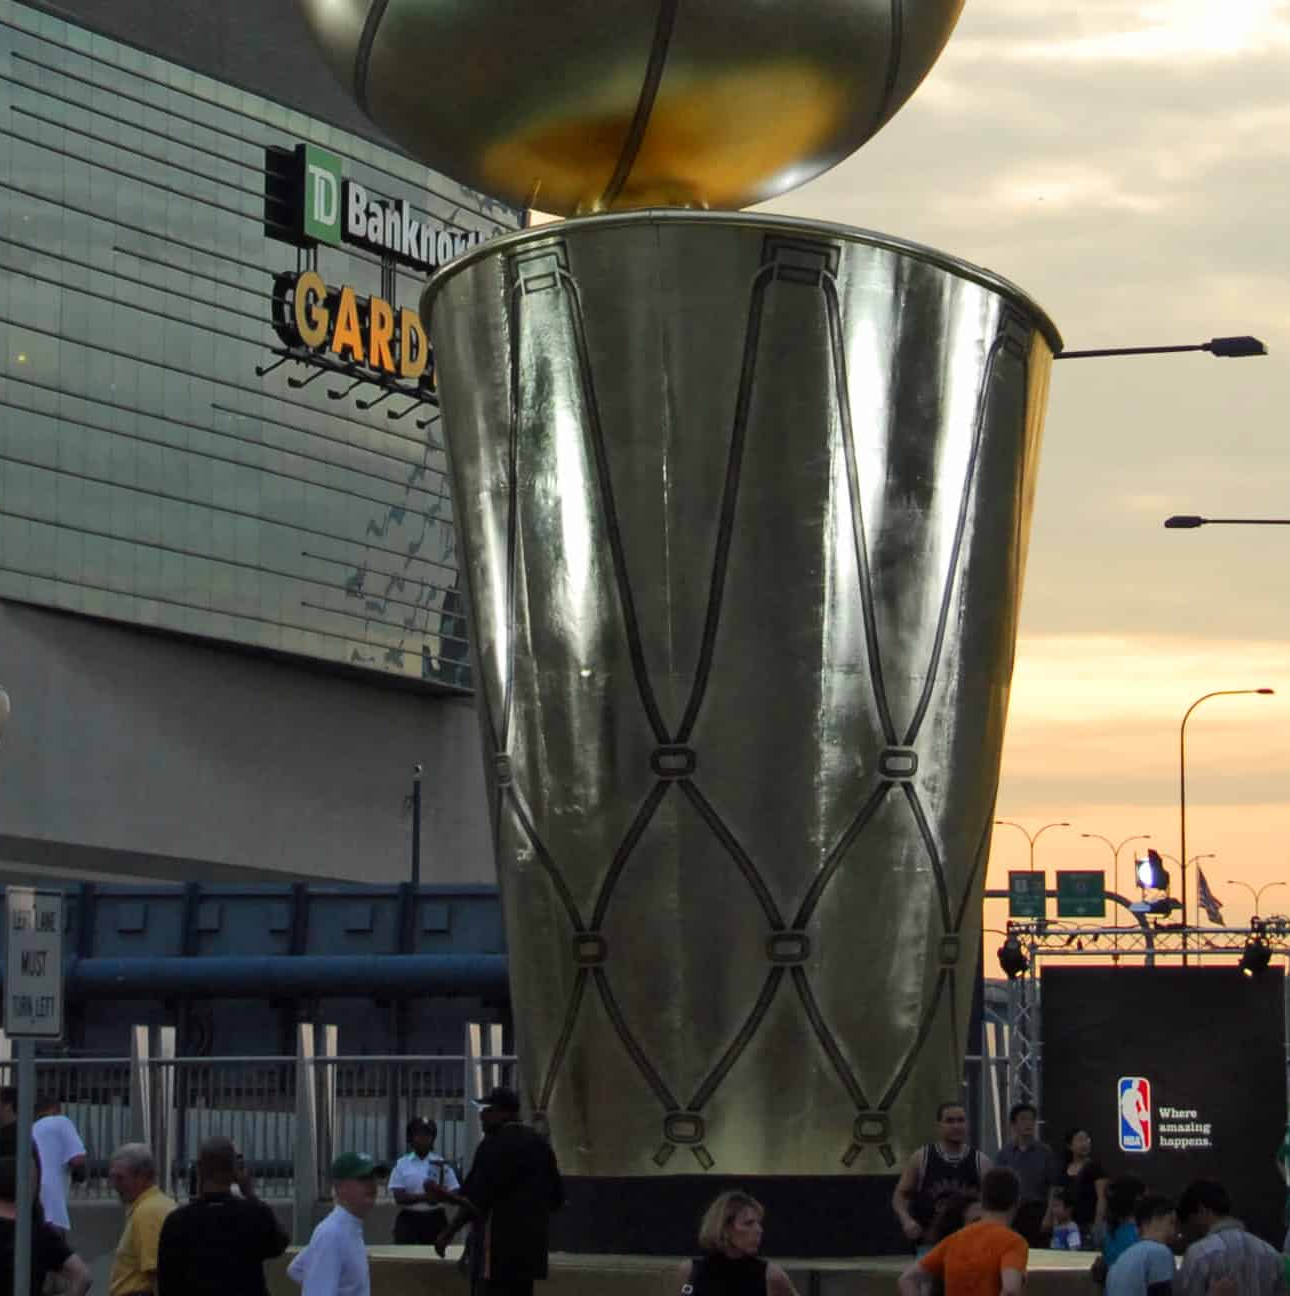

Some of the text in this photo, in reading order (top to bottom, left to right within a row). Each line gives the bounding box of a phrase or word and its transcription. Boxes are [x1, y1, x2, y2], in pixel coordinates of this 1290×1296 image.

[308, 164, 338, 226] TD
[294, 271, 438, 387] GARD
[36, 911, 56, 932] LANE
[20, 951, 47, 977] MUST
[12, 994, 55, 1017] TURN LEFT
[1158, 1106, 1198, 1120] Where
[1158, 1121, 1212, 1135] amazing
[1158, 1135, 1213, 1150] happens.
